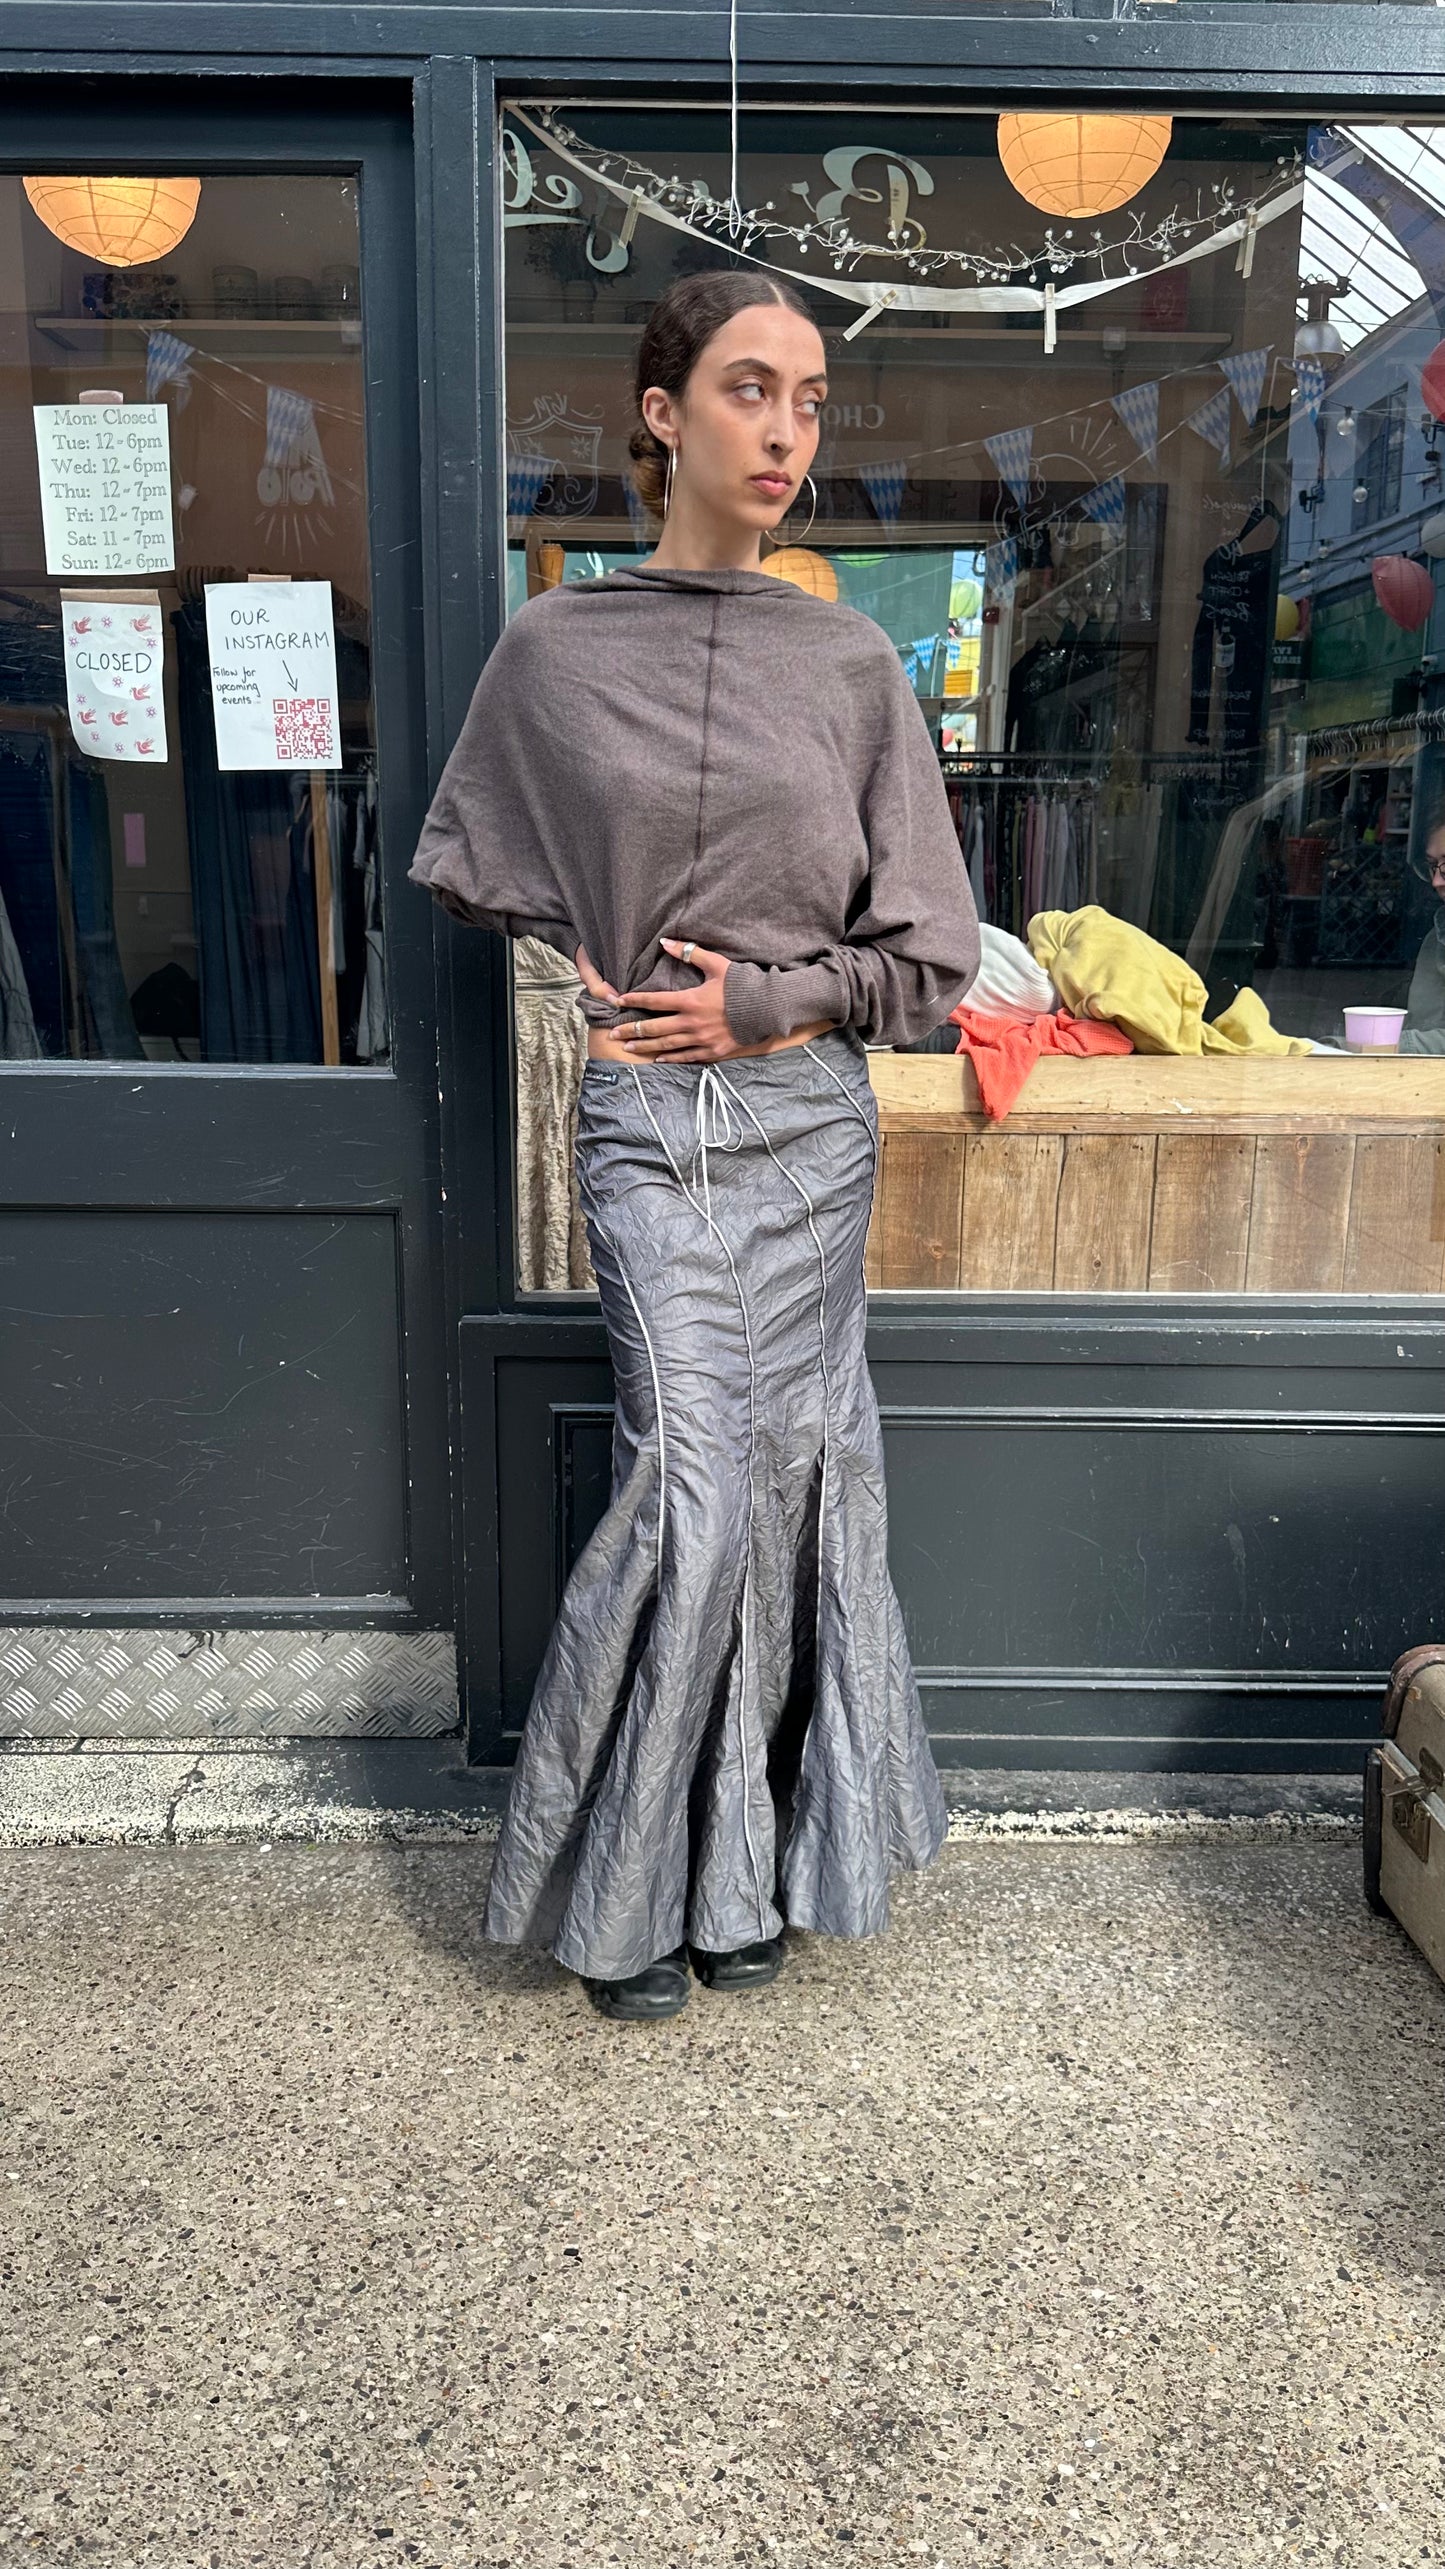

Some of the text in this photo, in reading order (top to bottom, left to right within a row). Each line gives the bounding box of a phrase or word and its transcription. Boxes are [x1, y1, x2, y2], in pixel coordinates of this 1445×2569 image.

[53, 408, 158, 426] Mon: Closed
[52, 434, 90, 450] Tue:
[51, 458, 97, 474] Wed:
[49, 483, 91, 498] Thu:
[65, 506, 94, 522] Fri:
[67, 530, 97, 546] Sat:
[61, 554, 99, 570] Sun:
[230, 608, 270, 626] OUR
[225, 631, 330, 650] INSTAGRAM
[75, 651, 152, 674] CLOSED
[212, 666, 256, 683] Follow for
[216, 682, 261, 698] upcoming
